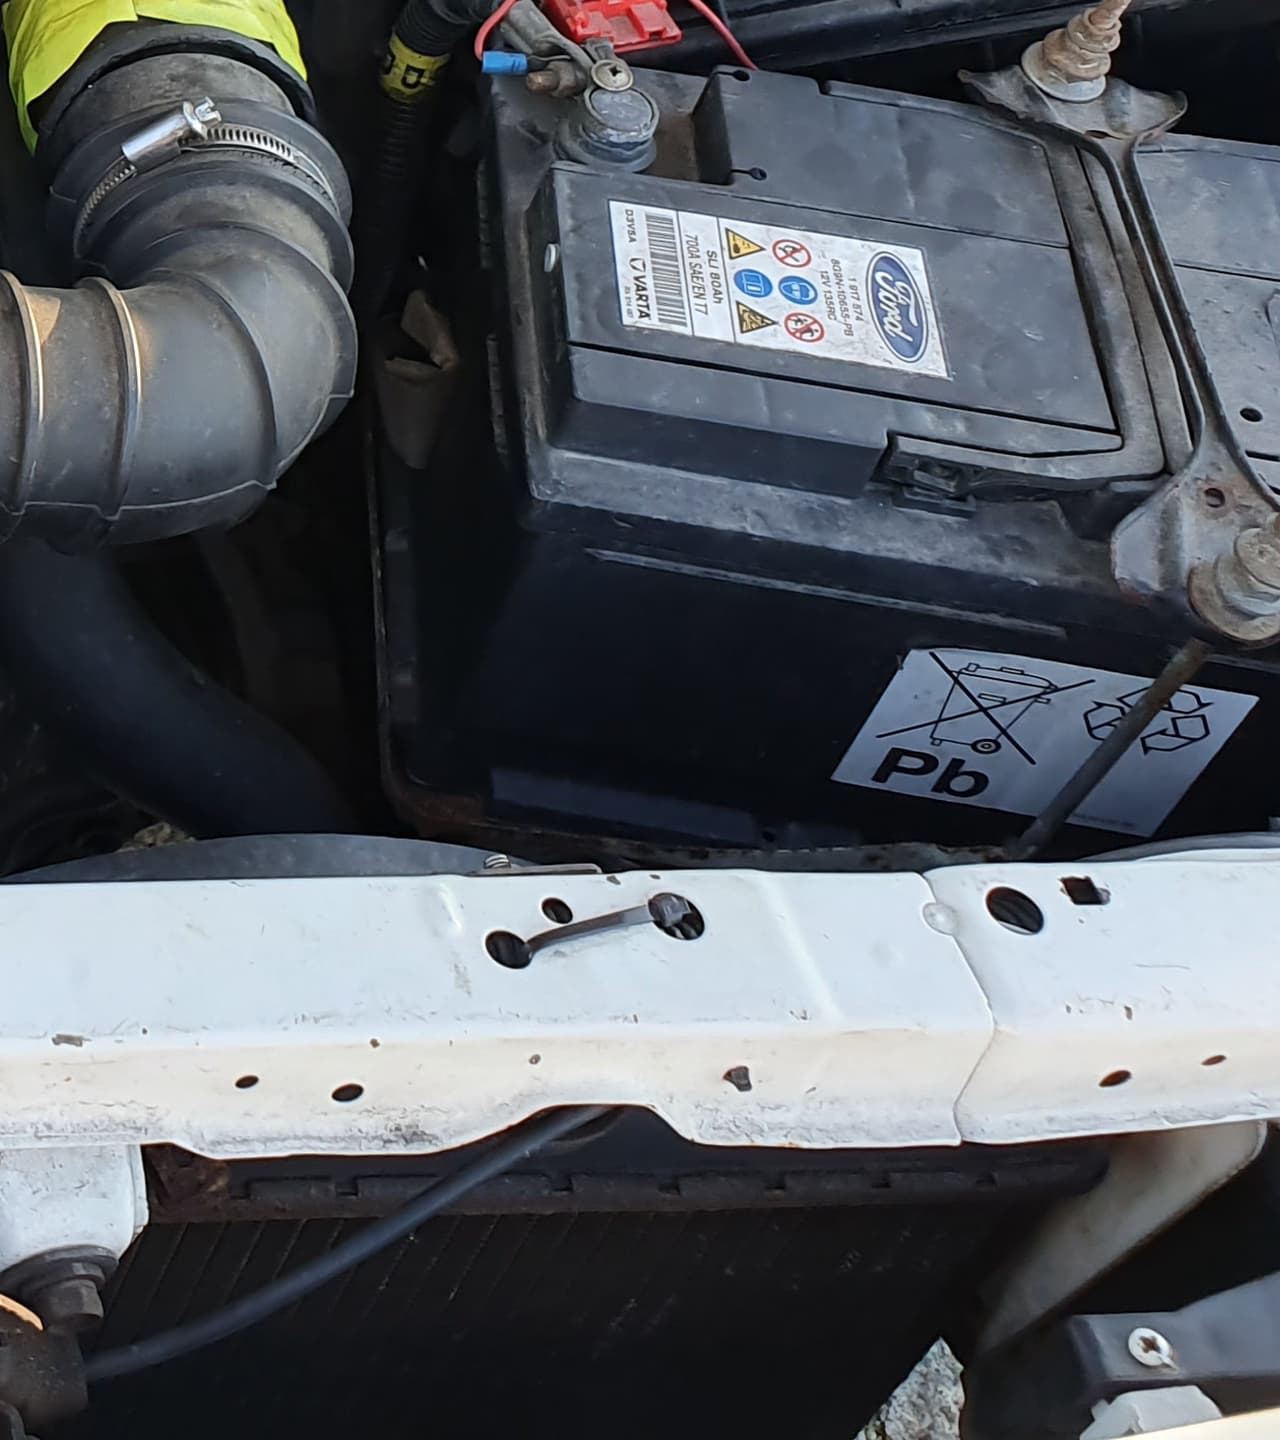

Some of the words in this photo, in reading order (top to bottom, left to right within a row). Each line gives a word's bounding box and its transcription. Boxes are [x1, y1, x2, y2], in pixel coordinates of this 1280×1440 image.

[684, 233, 702, 260] 700A
[706, 250, 720, 270] SLI
[633, 275, 651, 320] VARTA
[710, 272, 724, 305] 80Ah
[874, 271, 919, 343] Ford
[871, 746, 990, 798] Pb
